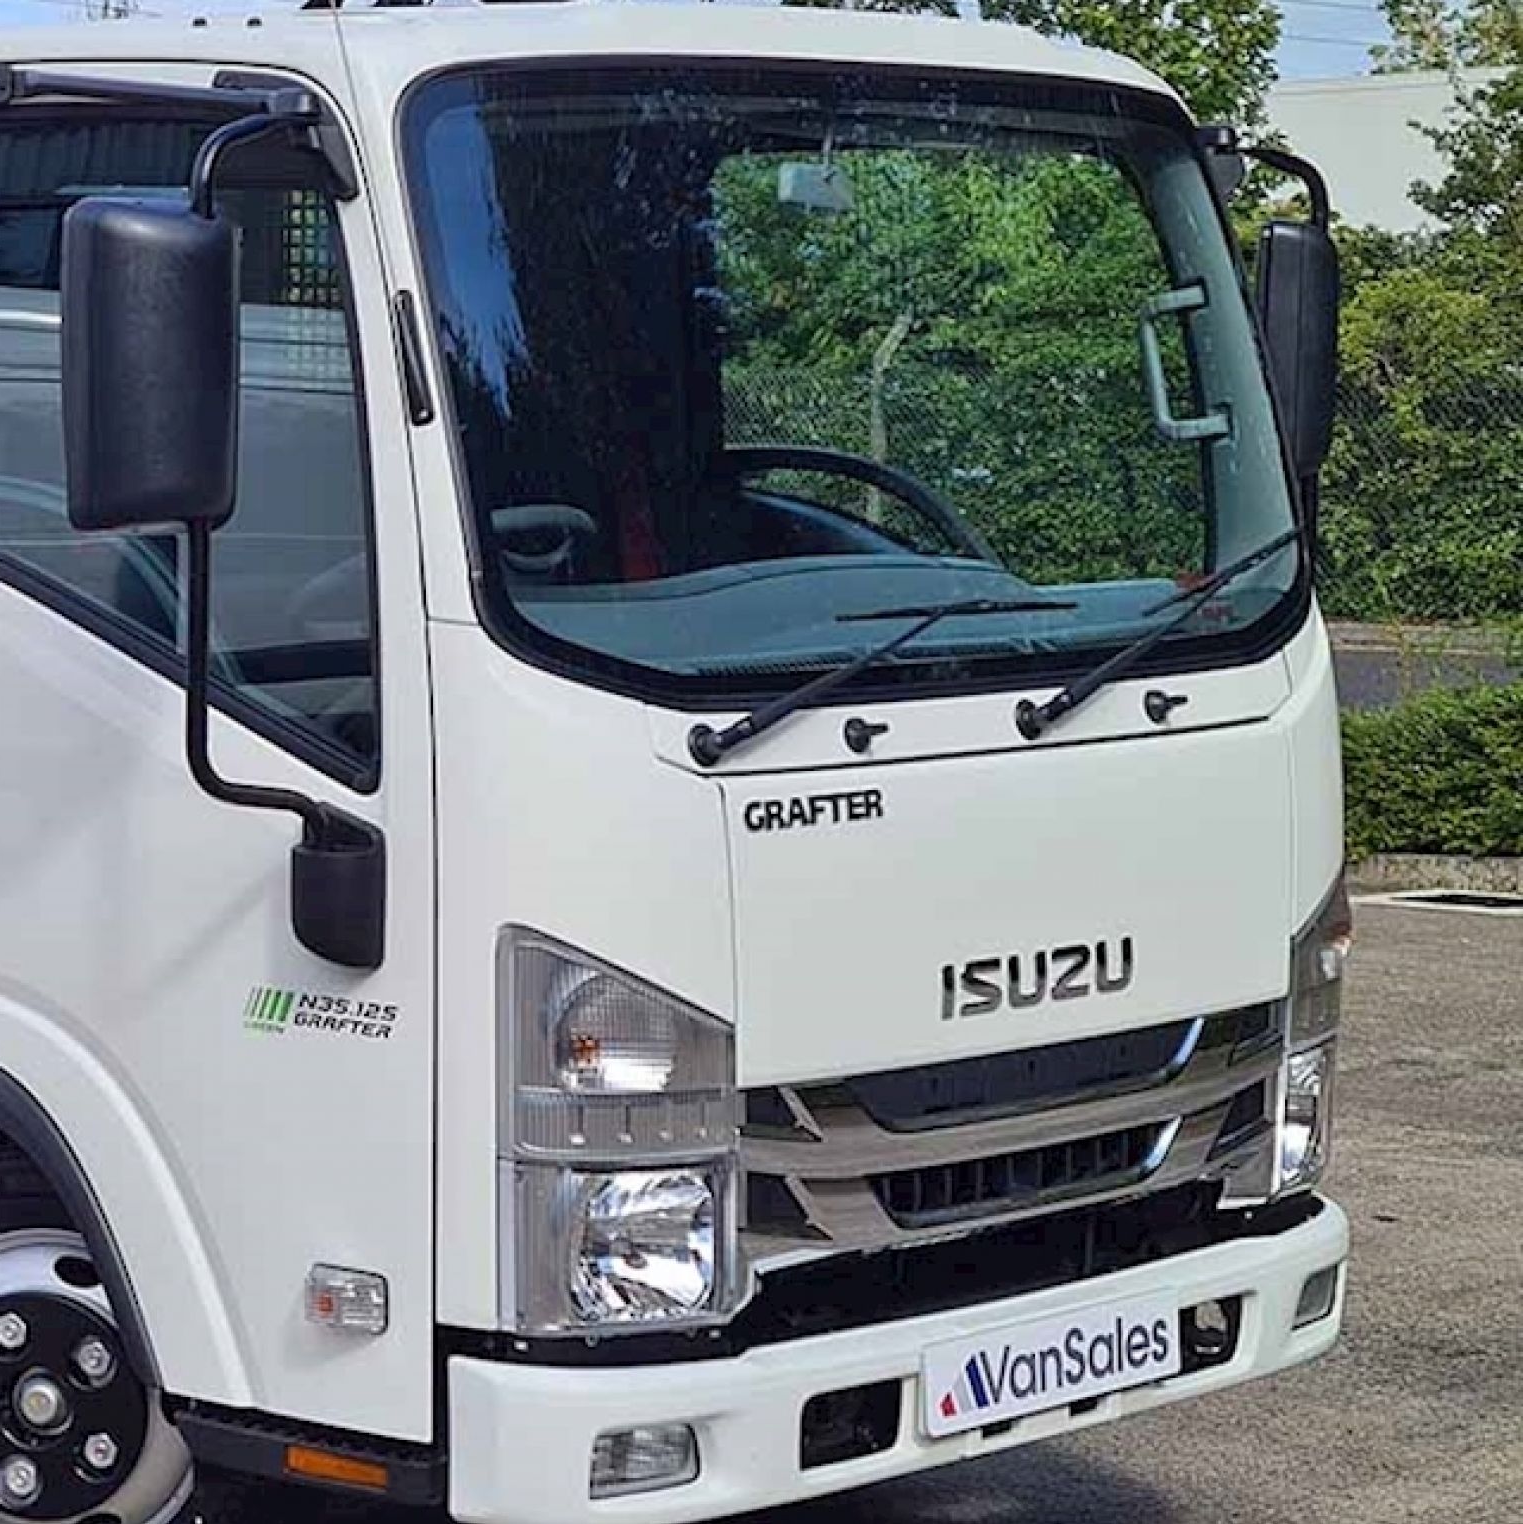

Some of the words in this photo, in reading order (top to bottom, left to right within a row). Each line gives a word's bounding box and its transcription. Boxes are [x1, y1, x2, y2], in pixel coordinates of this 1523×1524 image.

[744, 790, 884, 831] GRAFTER
[941, 937, 1133, 1021] ISUZU
[294, 1011, 391, 1039] GRAFTER
[978, 1315, 1168, 1403] VanSales
